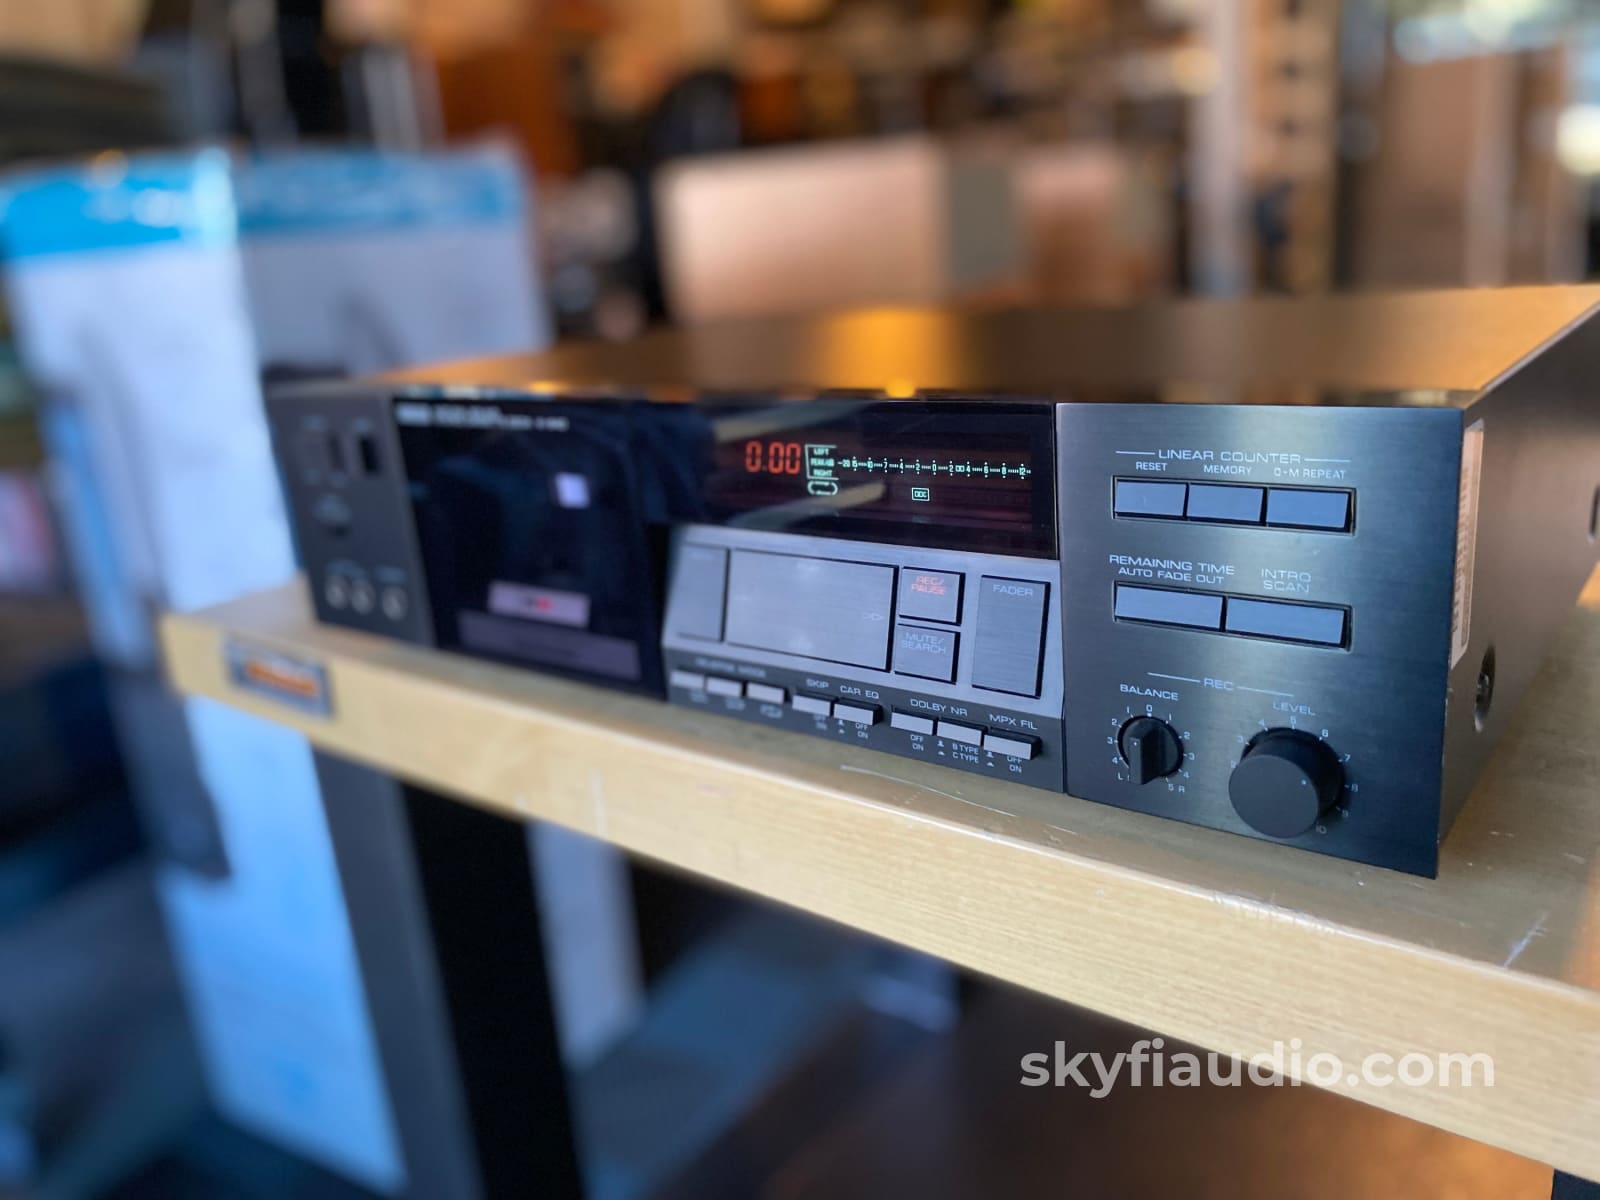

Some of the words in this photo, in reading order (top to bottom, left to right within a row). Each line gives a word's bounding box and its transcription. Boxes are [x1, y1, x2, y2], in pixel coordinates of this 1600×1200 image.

[745, 440, 801, 474] 0.00
[1158, 449, 1213, 460] LINEAR
[1220, 451, 1301, 464] COUNTER
[1135, 461, 1168, 471] RESET
[1203, 464, 1252, 475] MEMORY
[1302, 468, 1346, 479] REPEAT
[1109, 554, 1193, 571] REMAINING
[1198, 562, 1235, 575] TIME
[1118, 567, 1153, 578] AUTO
[1157, 570, 1192, 582] FADE
[1196, 574, 1225, 584] OUT
[1261, 568, 1312, 582] INTRO
[992, 584, 1033, 597] FADER
[1263, 580, 1310, 593] SCAN
[901, 640, 946, 654] SEARCH
[806, 678, 829, 688] SKIP
[1204, 678, 1233, 691] REC
[840, 685, 861, 696] CAR
[864, 689, 879, 699] EQ
[1120, 684, 1179, 701] BALANCE
[910, 699, 946, 713] DOLBY
[950, 706, 968, 716] NR
[1273, 701, 1316, 716] LEVEL
[989, 714, 1016, 726] MPX
[1020, 720, 1037, 730] FIL
[1111, 718, 1118, 726] 2
[910, 734, 925, 743] OFF
[1184, 731, 1191, 740] 2
[912, 743, 925, 752] ON
[960, 744, 979, 755] TYPE
[960, 753, 979, 764] TYPE
[1344, 753, 1351, 762] 7
[1009, 765, 1023, 773] ON
[1117, 772, 1123, 780] L
[1178, 785, 1185, 794] R
